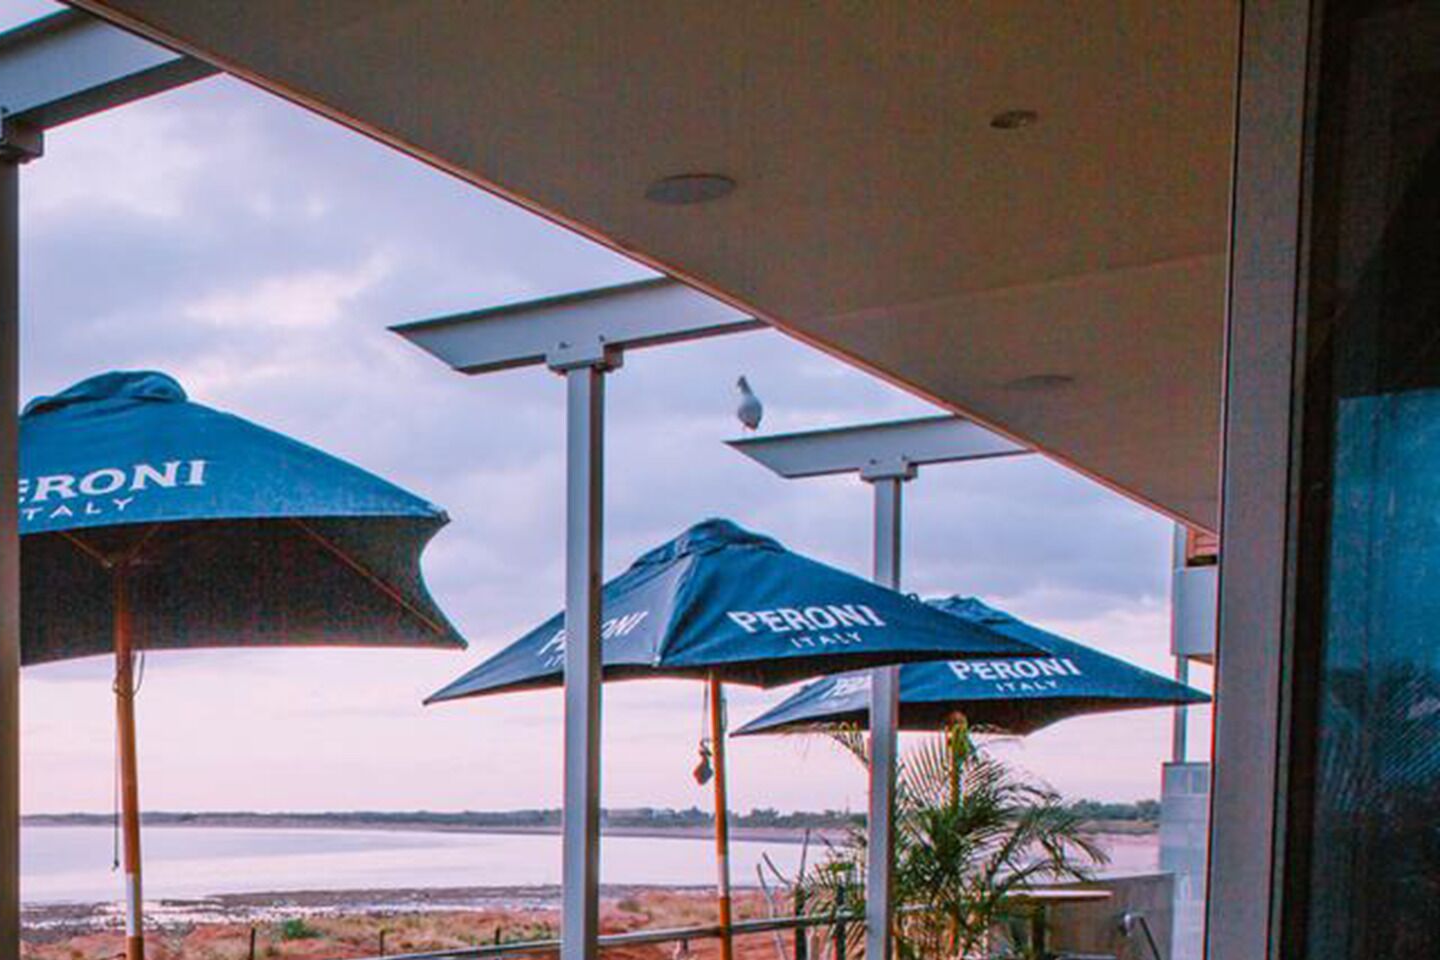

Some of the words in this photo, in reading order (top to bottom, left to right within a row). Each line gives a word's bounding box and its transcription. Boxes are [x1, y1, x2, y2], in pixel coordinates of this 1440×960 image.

[727, 605, 885, 632] PERONI
[791, 633, 863, 648] ITALY
[949, 657, 1081, 680] PERONI
[996, 680, 1060, 692] ITALY
